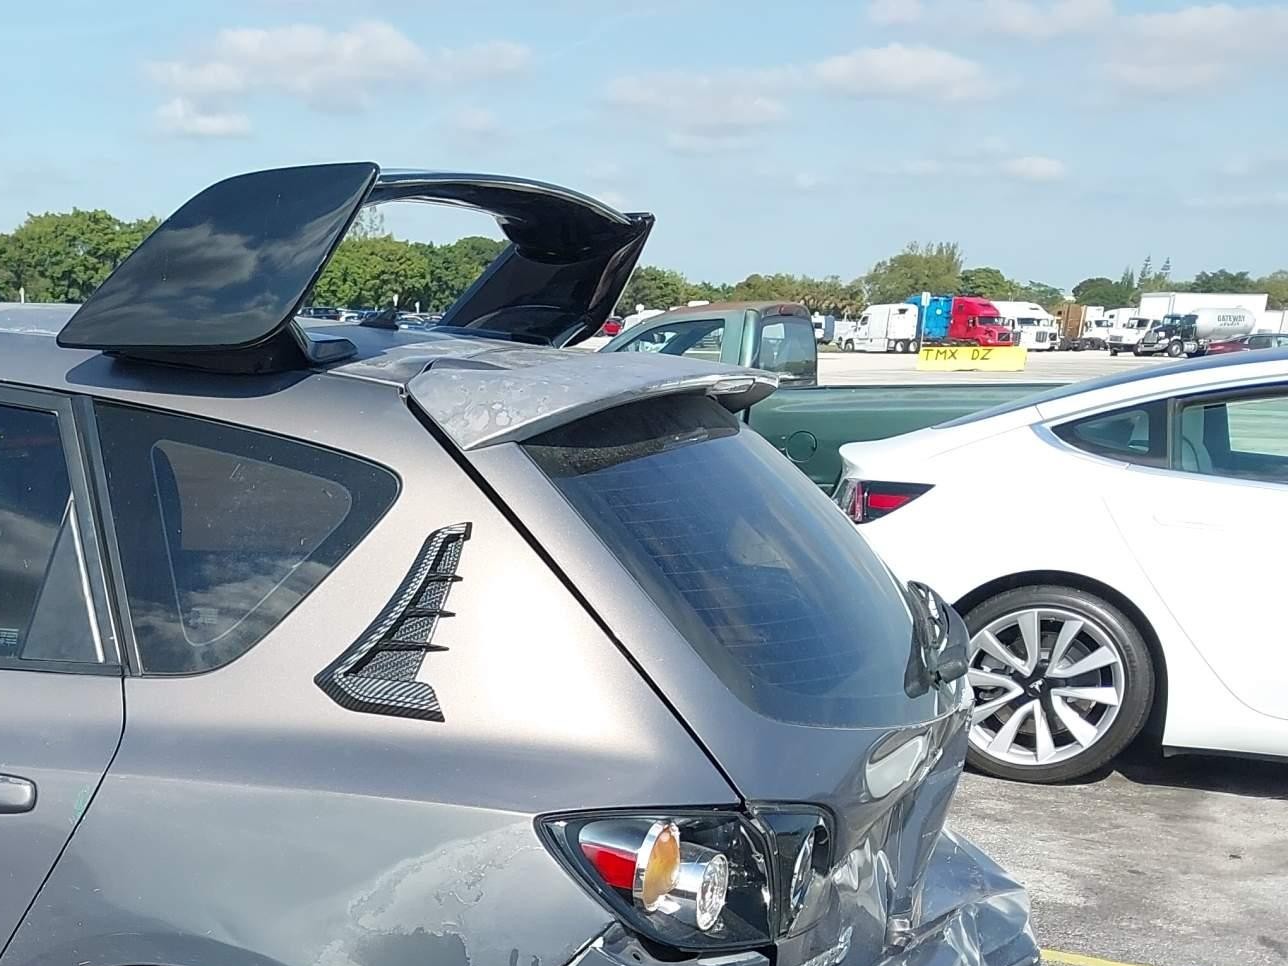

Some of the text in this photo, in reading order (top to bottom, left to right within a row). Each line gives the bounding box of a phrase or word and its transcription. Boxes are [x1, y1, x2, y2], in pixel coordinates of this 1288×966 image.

[1217, 314, 1246, 322] GATEWAY
[922, 348, 994, 361] TMX DZ
